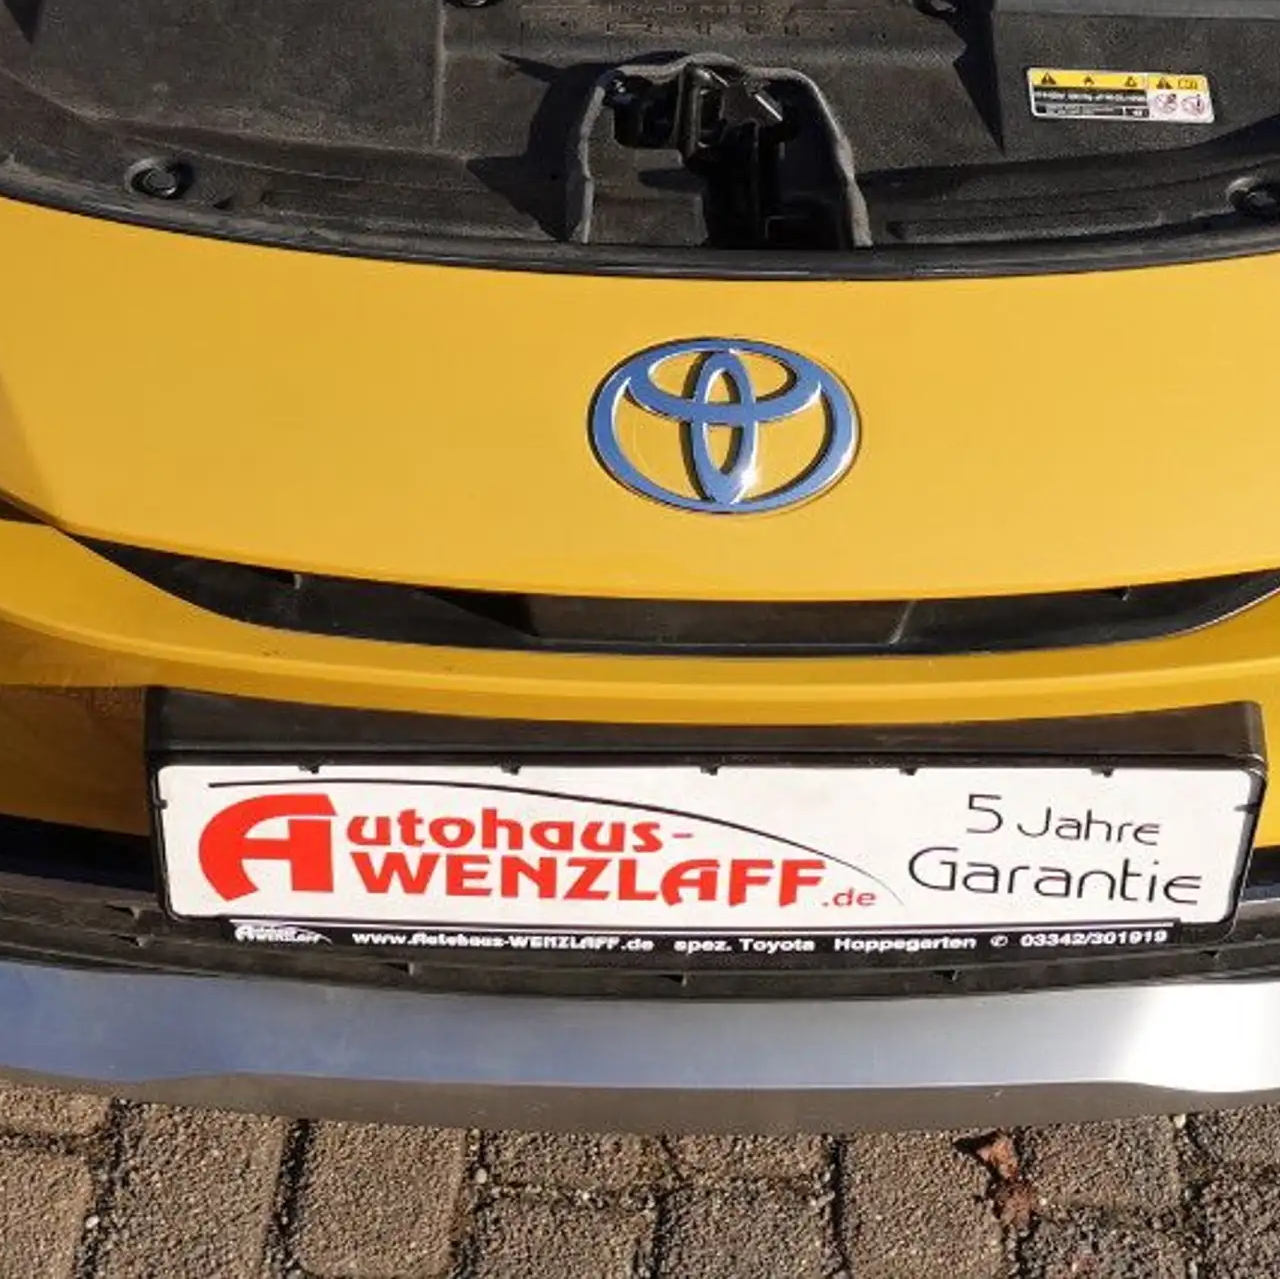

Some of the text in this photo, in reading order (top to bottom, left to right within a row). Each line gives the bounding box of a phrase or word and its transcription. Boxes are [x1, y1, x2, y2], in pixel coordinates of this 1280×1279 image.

[966, 793, 1161, 845] 5 Jahre
[198, 793, 694, 902] Autohaus-
[907, 846, 1203, 905] Garantie
[738, 938, 815, 954] Toyota
[834, 934, 977, 953] Hoppegarten
